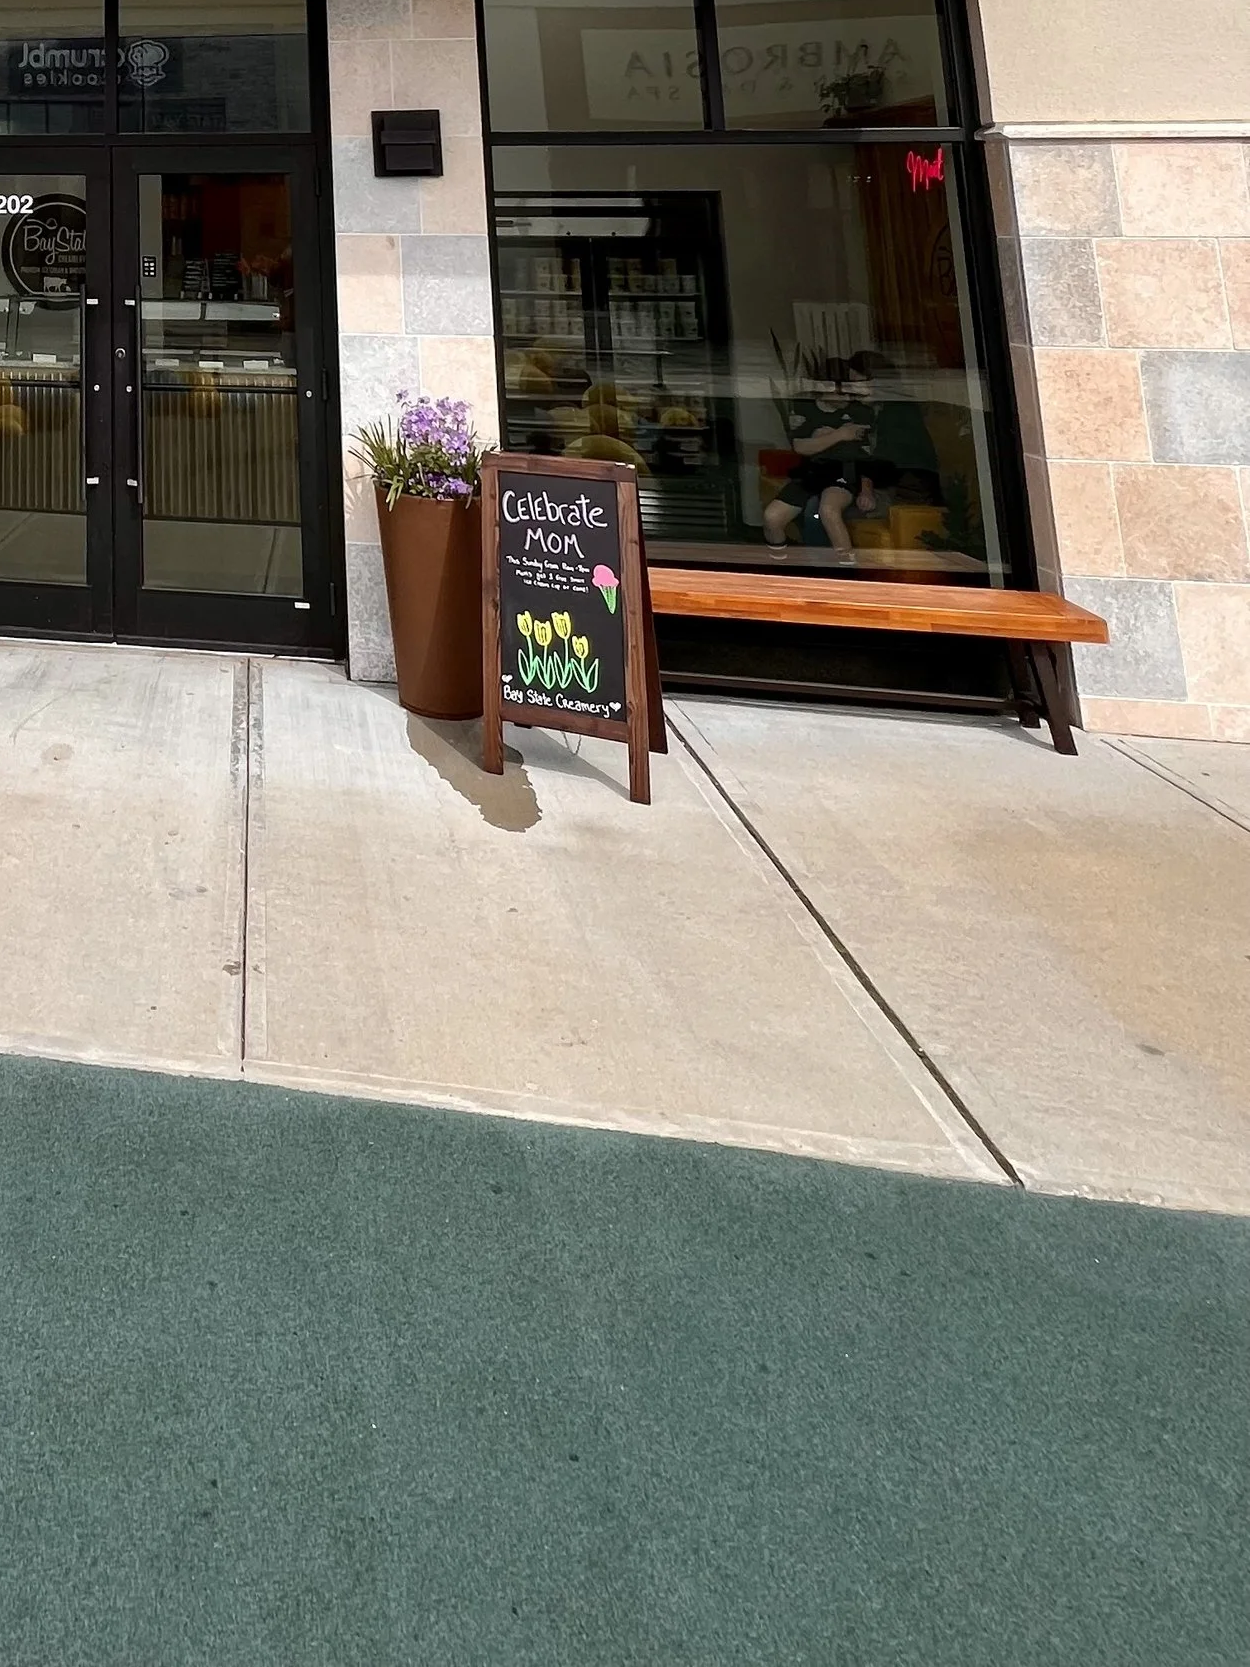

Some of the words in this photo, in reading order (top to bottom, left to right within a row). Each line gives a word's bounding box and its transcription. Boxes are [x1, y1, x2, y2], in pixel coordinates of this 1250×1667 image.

[23, 225, 59, 265] Bay
[55, 226, 87, 252] Stat
[524, 527, 585, 559] MOM
[503, 684, 523, 704] Bay
[526, 688, 553, 707] State
[555, 693, 611, 719] Creamery
